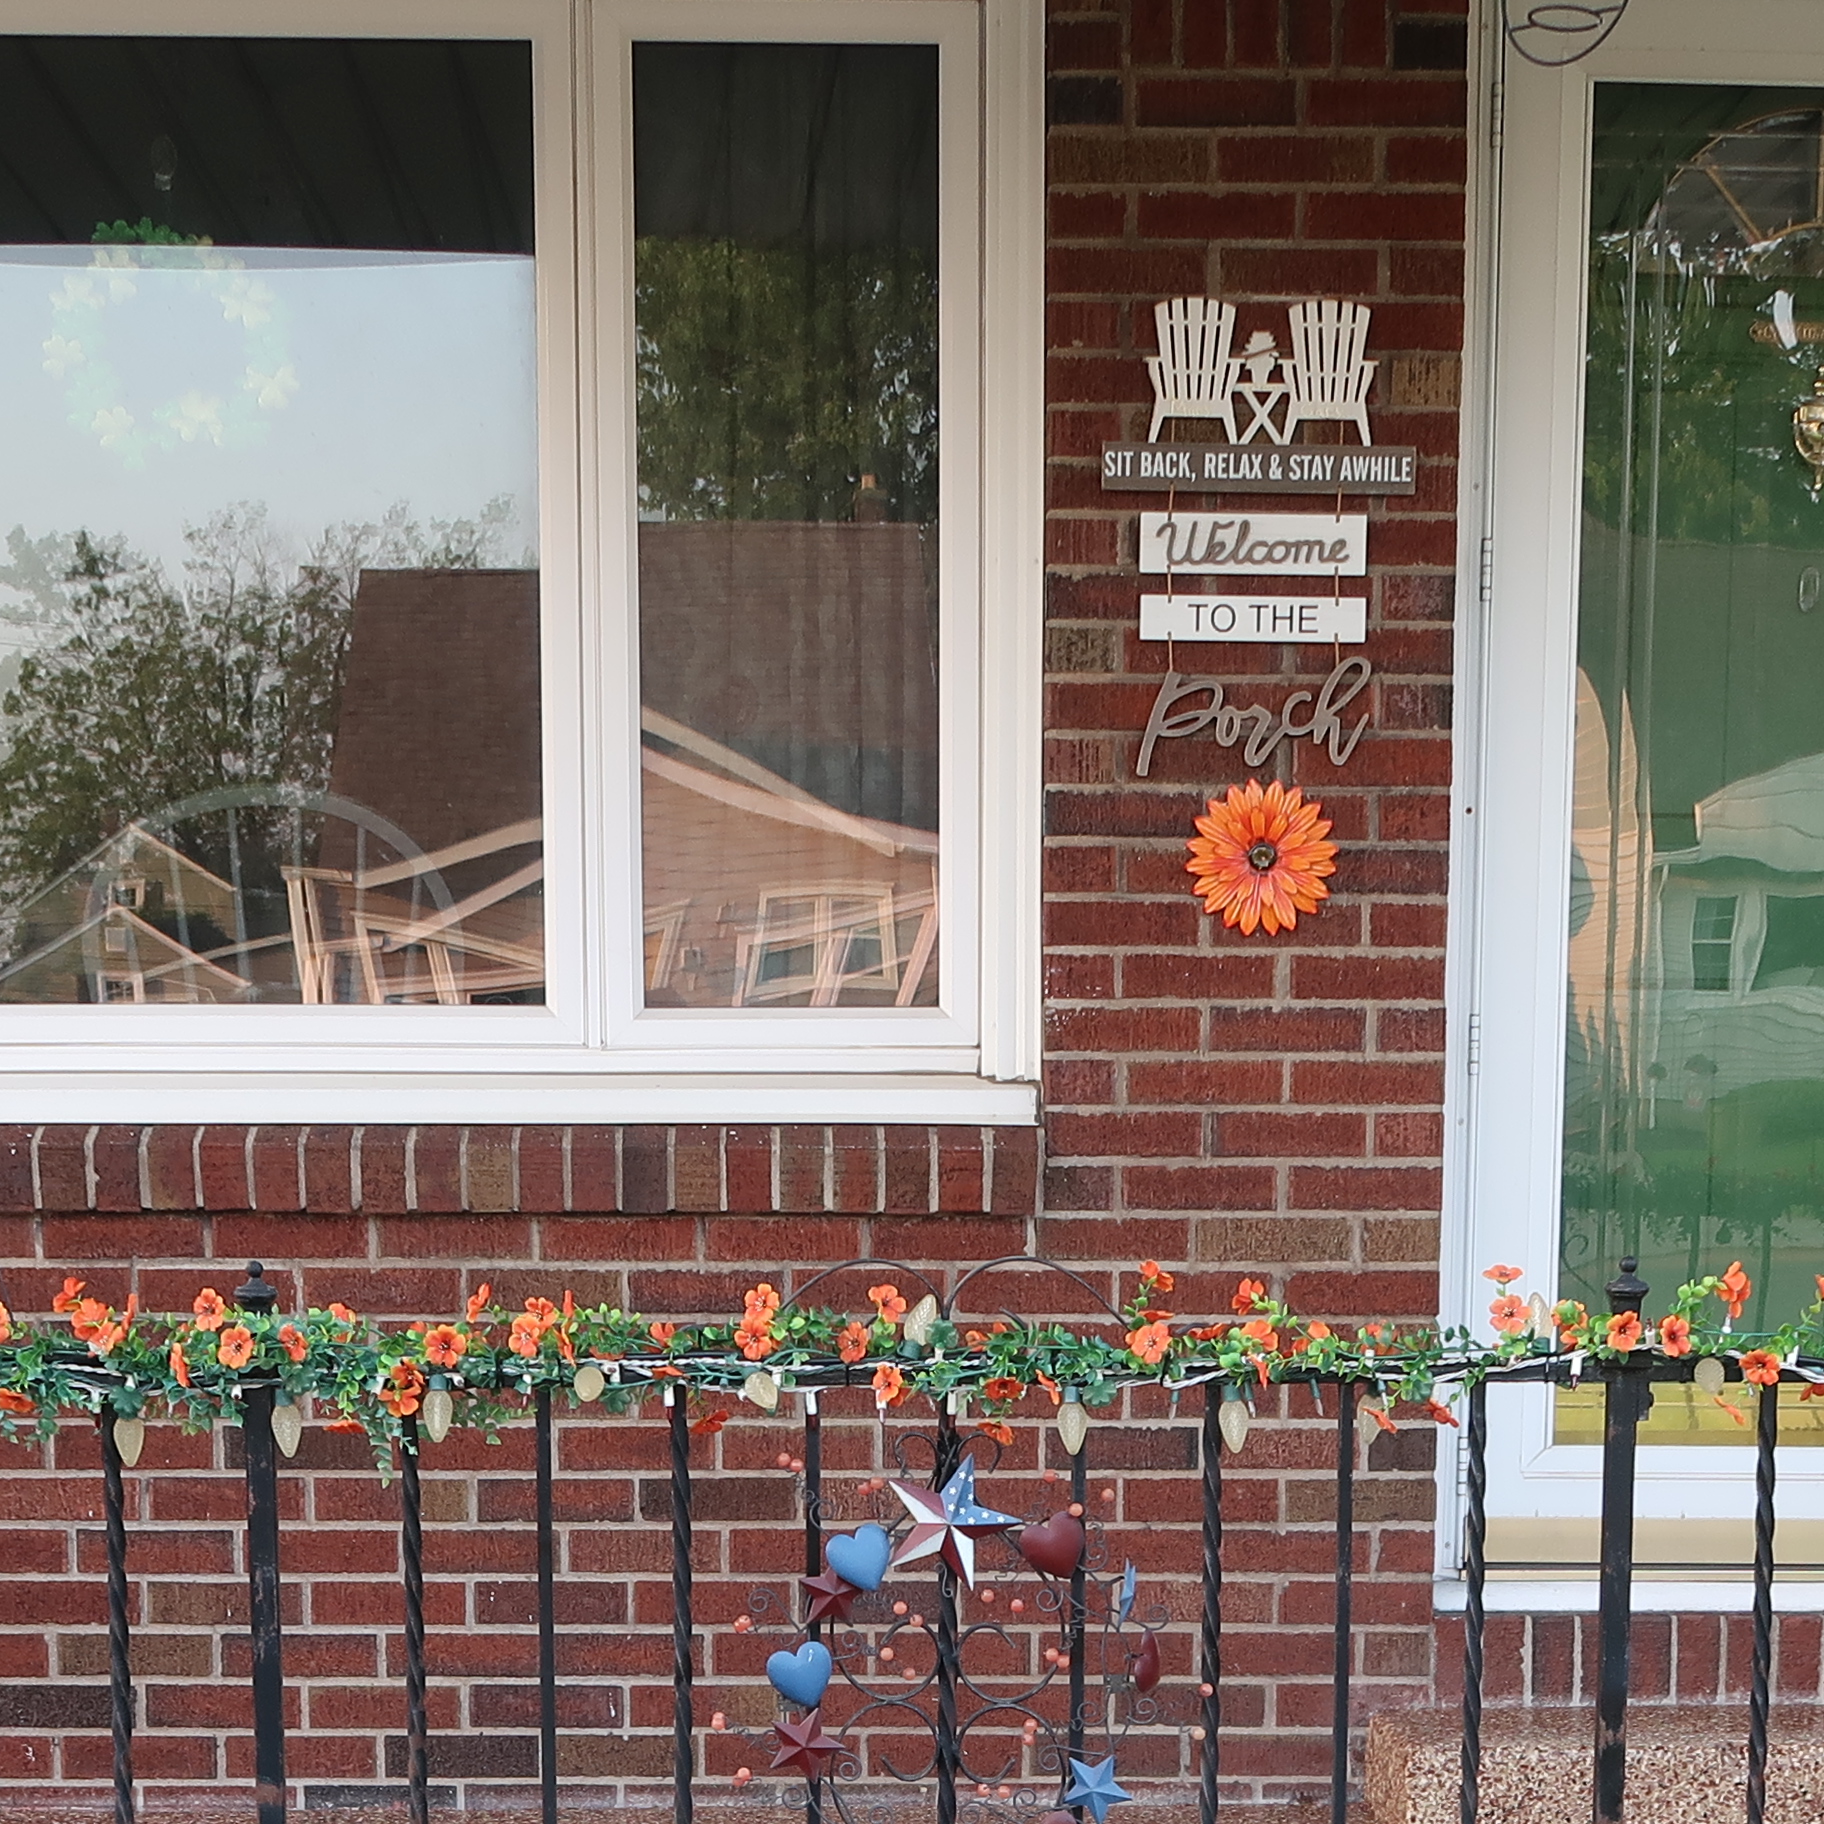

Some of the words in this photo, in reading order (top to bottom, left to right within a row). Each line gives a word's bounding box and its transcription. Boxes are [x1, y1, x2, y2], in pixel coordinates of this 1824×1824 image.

[1104, 450, 1134, 478] SIT
[1140, 451, 1196, 483] BACK,
[1204, 453, 1262, 480] RELAX
[1268, 454, 1283, 481] &
[1289, 454, 1335, 482] STAY
[1339, 455, 1412, 483] AWHILE
[1156, 519, 1350, 566] Welcome
[1188, 603, 1237, 633] TO
[1249, 603, 1319, 634] THE
